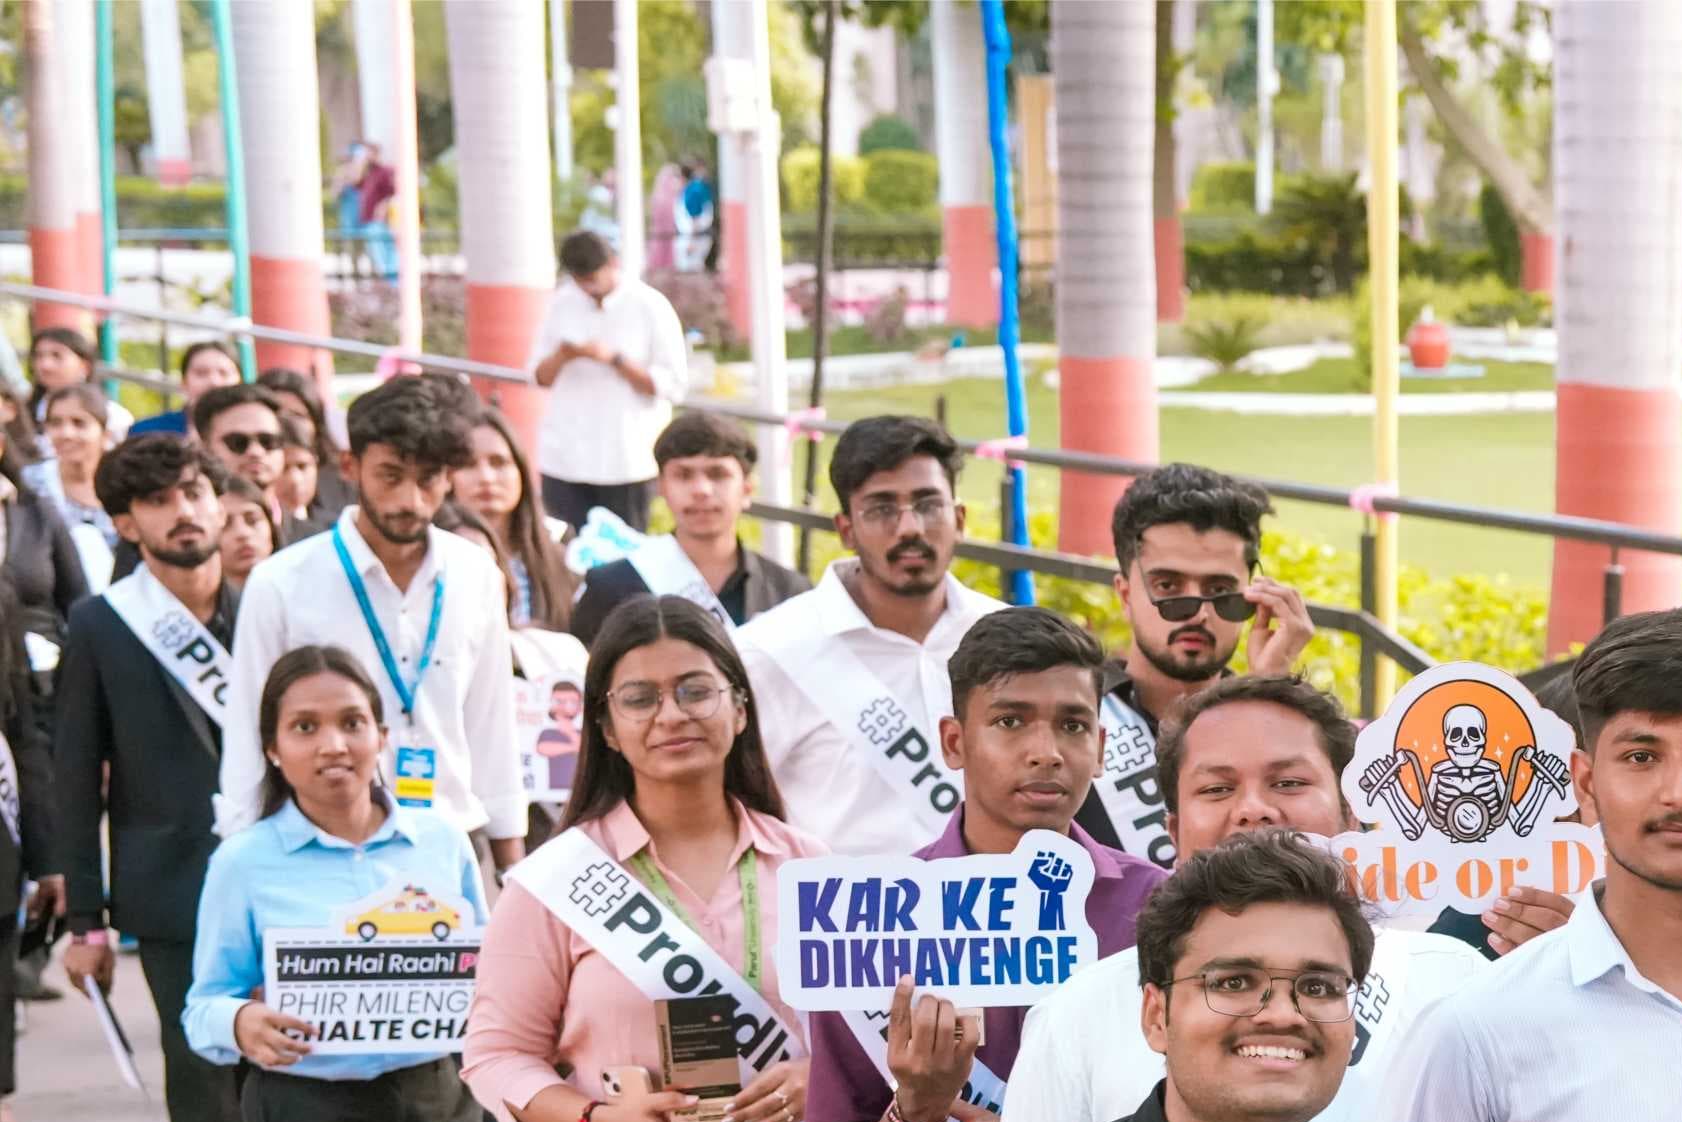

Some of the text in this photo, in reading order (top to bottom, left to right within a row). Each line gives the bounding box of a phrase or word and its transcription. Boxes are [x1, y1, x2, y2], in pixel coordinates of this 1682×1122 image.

[1342, 840, 1596, 903] ide or D
[798, 877, 921, 932] KAR
[941, 877, 1017, 932] KE
[282, 951, 480, 975] Hum Hai Raahi P
[800, 936, 1077, 988] DIKHAYENGE
[279, 989, 476, 1015] PHIR MILENG
[280, 1019, 404, 1042] HALTE
